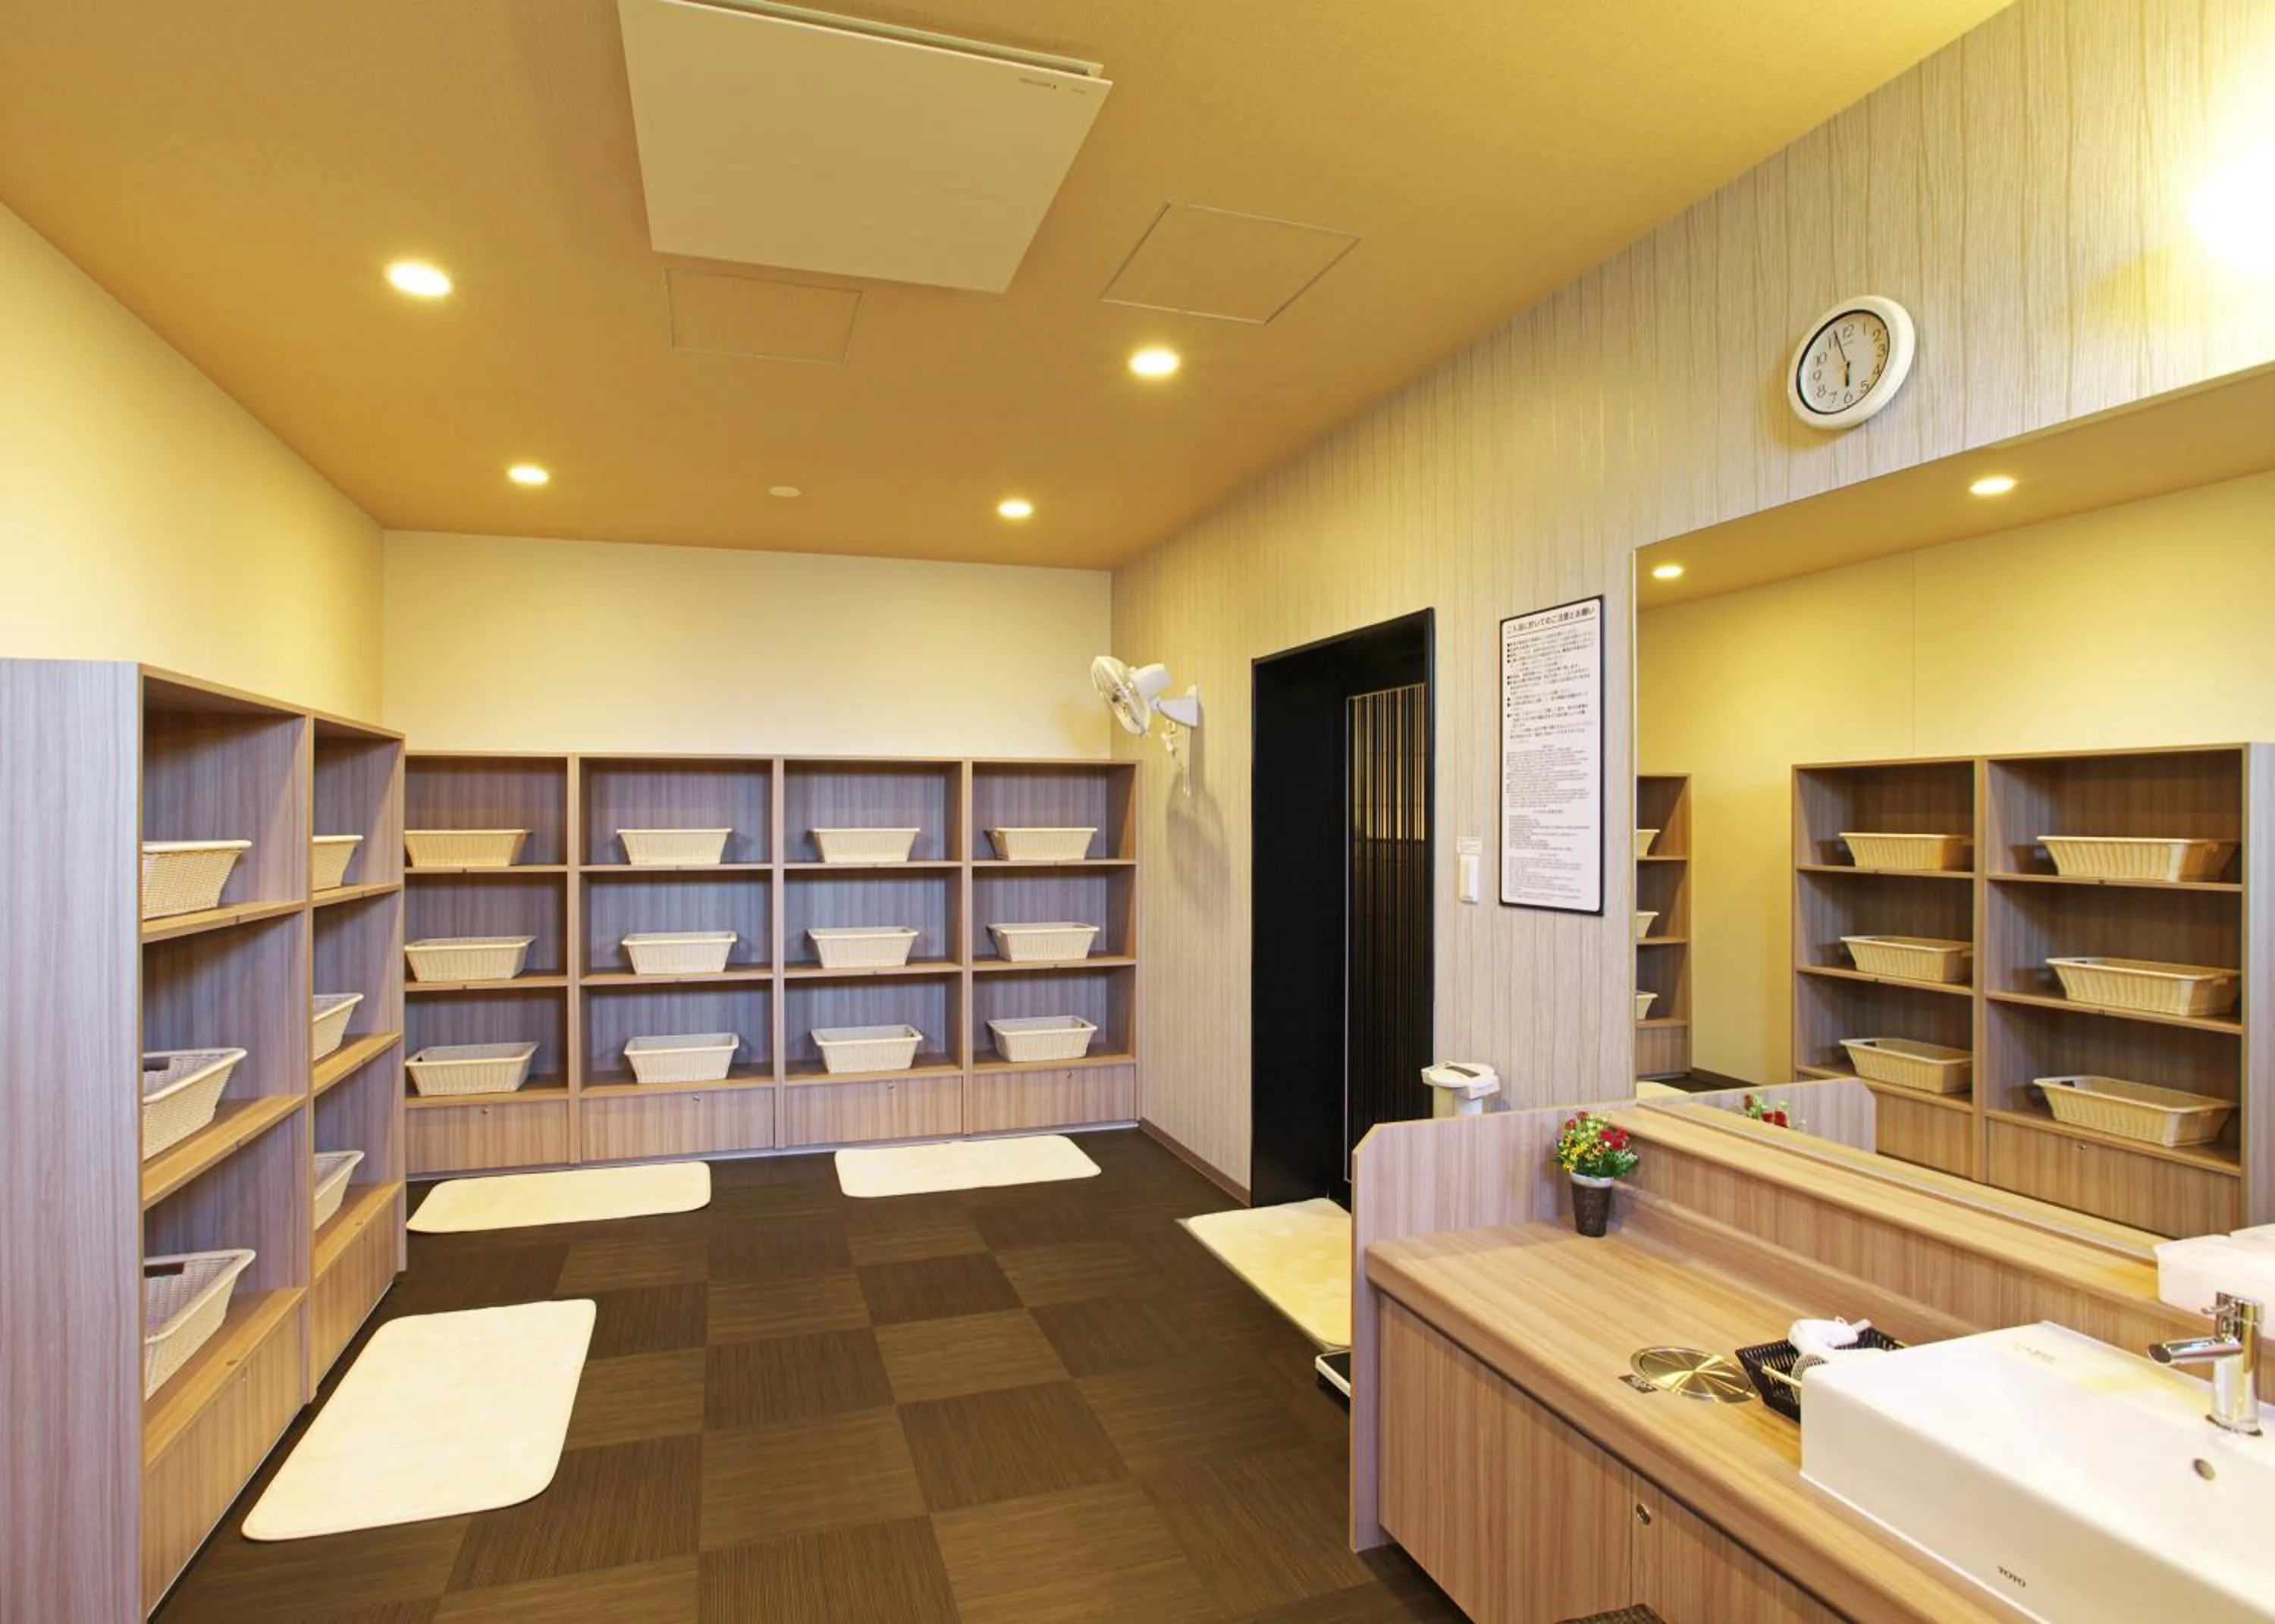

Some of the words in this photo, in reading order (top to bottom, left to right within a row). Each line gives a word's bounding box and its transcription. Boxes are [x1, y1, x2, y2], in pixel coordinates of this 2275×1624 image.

[1842, 324, 1854, 339] 12
[1872, 328, 1881, 343] 2
[1828, 331, 1837, 349] 11
[1876, 344, 1885, 357] 3
[1815, 351, 1828, 367] 10
[1812, 369, 1822, 382] 9
[1872, 364, 1881, 377] 4
[1816, 384, 1826, 398] 8
[1860, 380, 1869, 394] 5
[1829, 391, 1837, 403] 7
[1844, 391, 1853, 403] 6
[1997, 1565, 2026, 1587] TOTO
